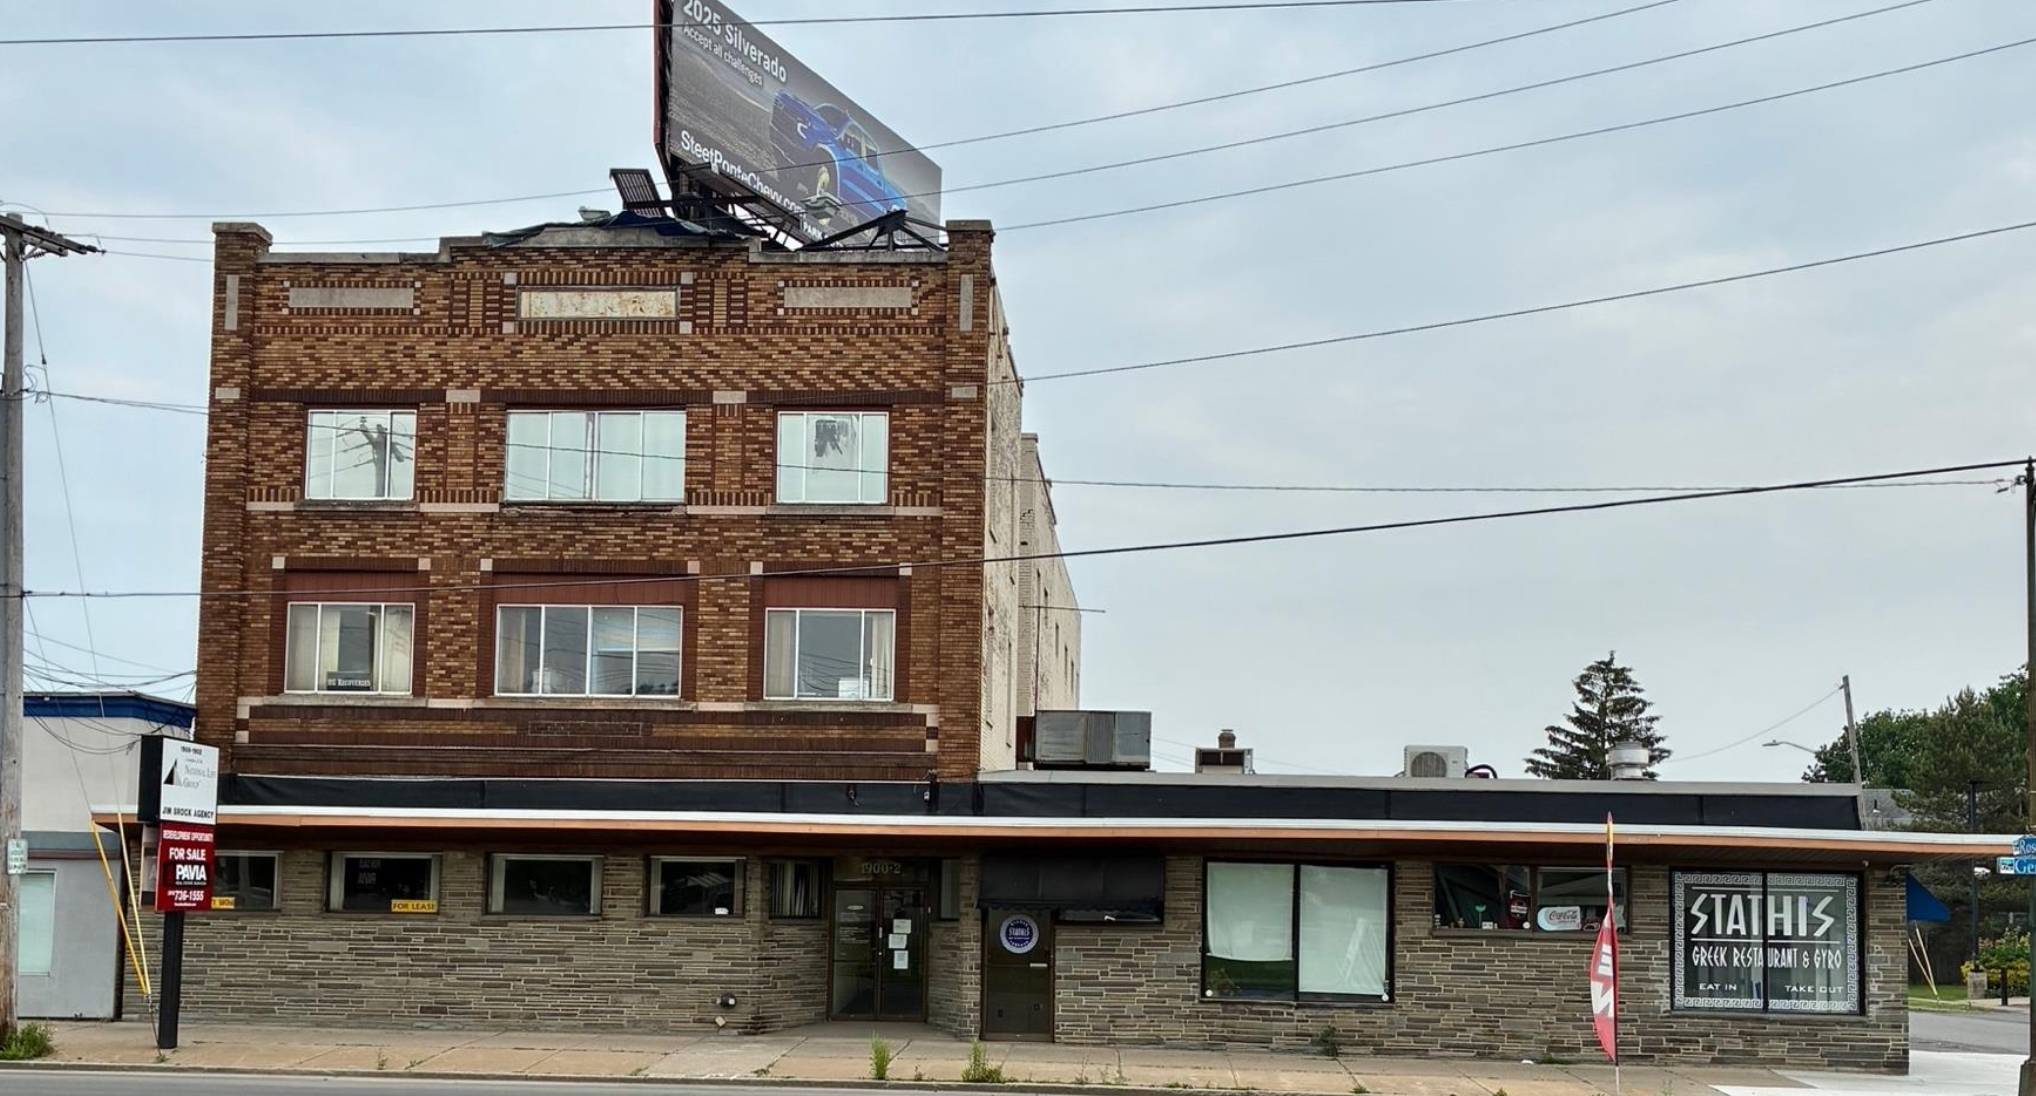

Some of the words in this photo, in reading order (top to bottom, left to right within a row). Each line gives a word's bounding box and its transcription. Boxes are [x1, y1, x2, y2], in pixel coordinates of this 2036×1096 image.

[683, 0, 721, 35] 2025
[725, 24, 786, 82] Silverado
[683, 22, 712, 51] Accept
[713, 43, 723, 58] all
[723, 51, 763, 86] challenges
[162, 806, 172, 815] JIM
[174, 808, 192, 817] BROCK
[193, 809, 214, 819] AGENCY
[169, 847, 185, 860] FOR
[186, 848, 207, 861] SALE
[175, 864, 207, 881] PAVIA
[392, 902, 408, 910] FOR
[411, 902, 435, 910] LEASE
[1690, 893, 1835, 937] STATHIS
[1692, 946, 1728, 967] GREEK
[1733, 946, 1798, 969] RESTAURANT
[1802, 950, 1810, 968] &
[1813, 948, 1842, 969] GYRO
[1784, 985, 1814, 993] TAKE
